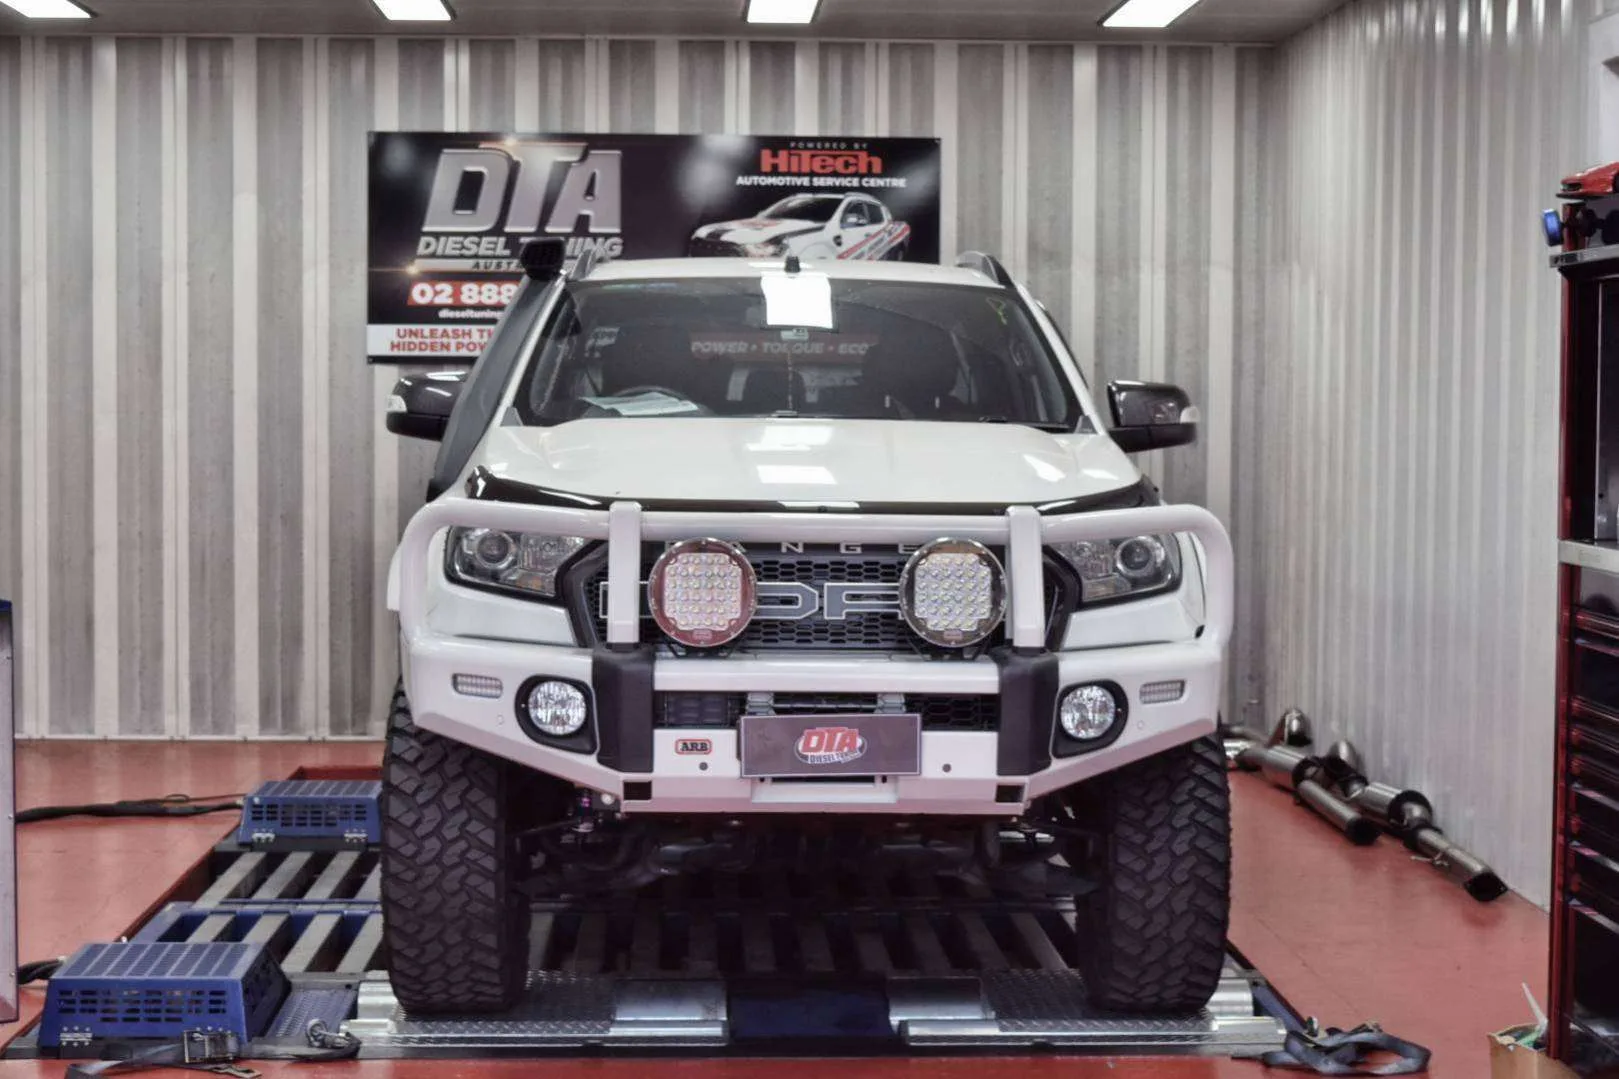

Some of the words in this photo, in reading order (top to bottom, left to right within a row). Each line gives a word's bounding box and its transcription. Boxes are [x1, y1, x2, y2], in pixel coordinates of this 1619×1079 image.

[760, 149, 882, 174] HiTech
[421, 142, 622, 233] DTA
[736, 176, 811, 188] AUTOMOTIVE
[812, 177, 859, 188] SERVICE
[861, 178, 907, 189] CENTRE
[416, 236, 512, 257] DIESEL
[411, 283, 453, 304] 02
[397, 328, 472, 340] UNLEASH
[390, 341, 451, 353] HIDDEN
[691, 342, 748, 355] POWER
[680, 742, 709, 752] ARB
[801, 727, 859, 754] DTA
